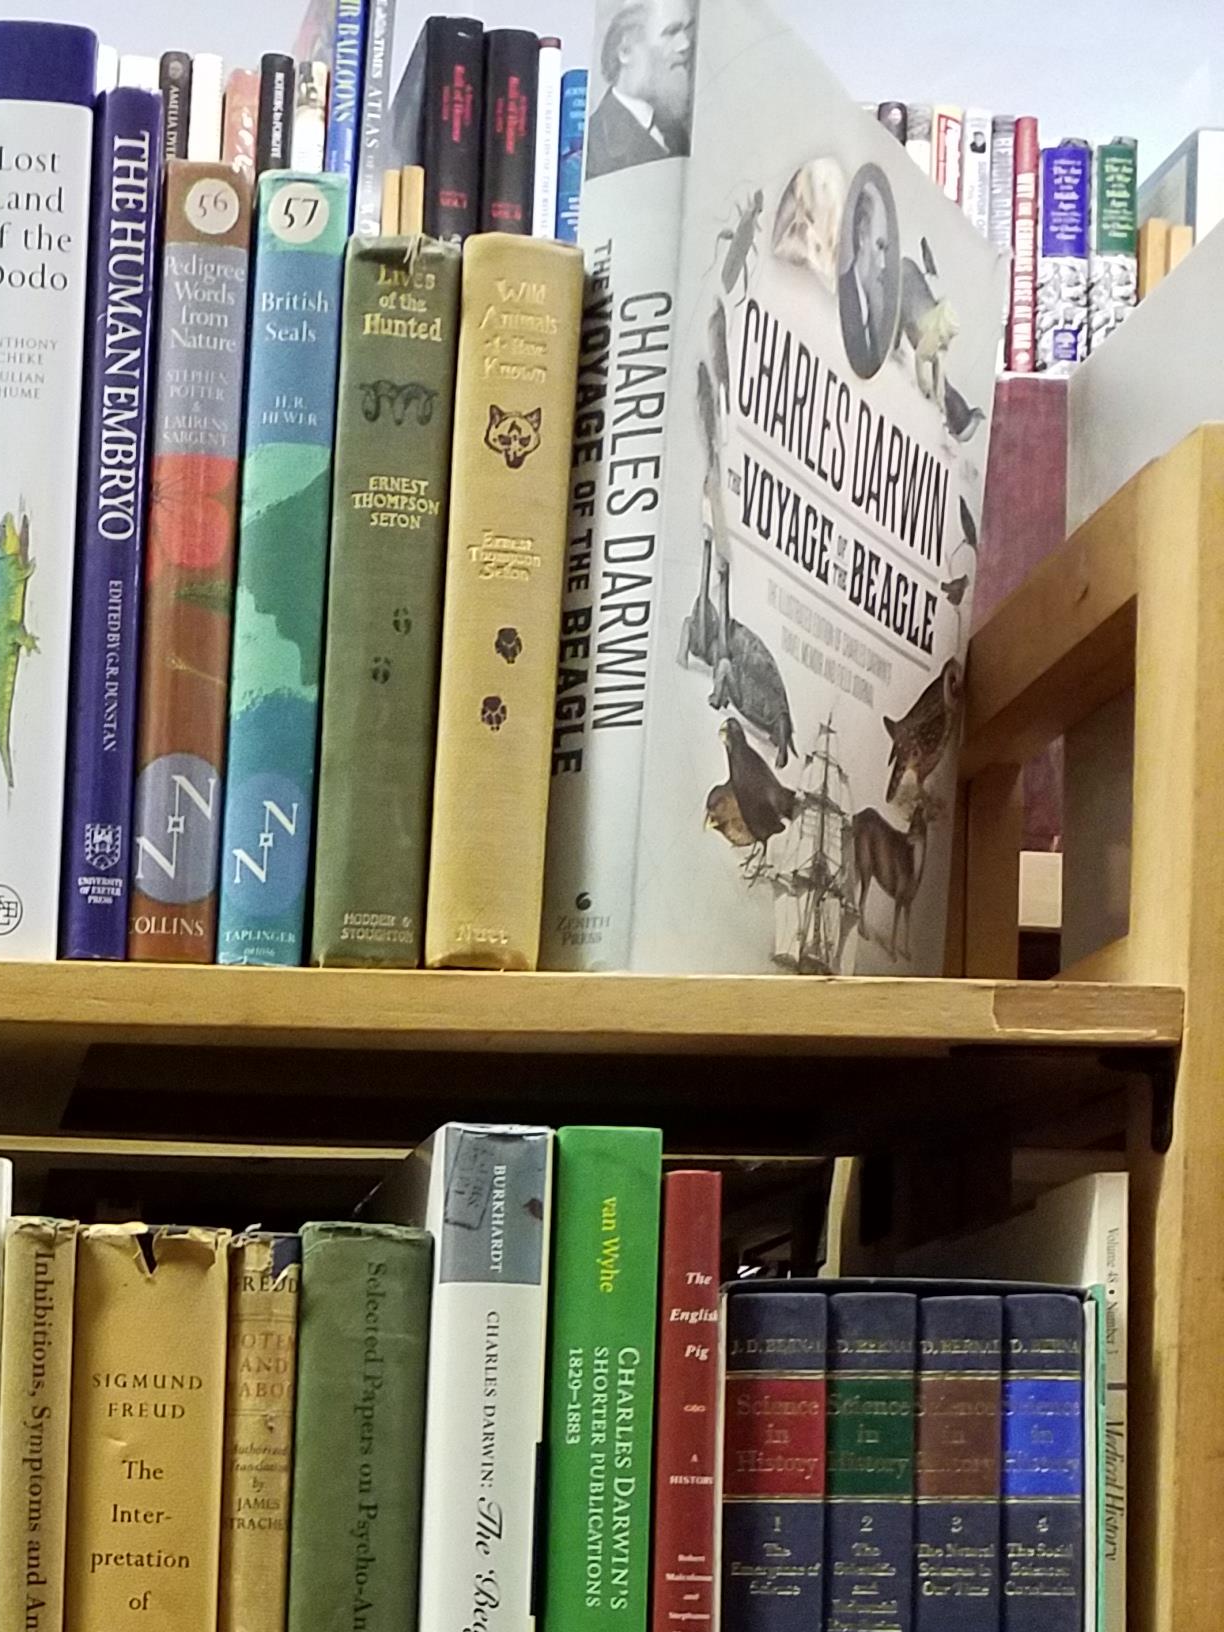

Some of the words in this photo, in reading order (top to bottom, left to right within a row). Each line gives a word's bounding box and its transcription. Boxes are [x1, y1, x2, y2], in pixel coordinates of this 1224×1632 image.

[110, 130, 150, 214] THE
[196, 193, 225, 218] 56
[282, 197, 320, 229] 57
[22, 225, 72, 253] the
[164, 256, 246, 283] Pedigree
[591, 239, 612, 291] THE
[103, 219, 148, 378] HUMAN
[174, 281, 235, 306] Words
[261, 292, 329, 313] British
[379, 294, 397, 313] of
[400, 293, 427, 313] the
[179, 305, 229, 329] from
[362, 313, 442, 343] Hunted
[170, 328, 236, 354] Nature
[266, 323, 317, 343] Seals
[572, 292, 613, 468] VOYAGE
[607, 291, 673, 516] CHARLES
[738, 299, 851, 492] CHARLES
[850, 399, 949, 567] DARWIN
[97, 385, 142, 541] EMBRYO
[368, 476, 428, 494] ERNEST
[571, 480, 596, 517] OF
[352, 493, 440, 516] THOMPSON
[370, 511, 421, 529] SETON
[567, 528, 593, 593] THE
[740, 453, 834, 586] VOYAGE
[848, 538, 938, 655] BEAGLE
[592, 534, 656, 729] DARWIN
[551, 605, 593, 776] BEAGLE
[489, 1164, 507, 1273] BURKHARDT
[600, 1196, 617, 1232] van
[598, 1237, 620, 1294] Wyhe
[686, 1271, 713, 1286] The
[669, 1308, 720, 1323] English
[685, 1344, 710, 1361] Pig
[92, 1373, 203, 1391] SIGMUND
[108, 1402, 185, 1420] FREUD
[615, 1347, 640, 1468] CHARLES
[122, 1459, 164, 1481] The
[111, 1504, 172, 1525] Inter-
[610, 1476, 636, 1610] DARWIN'S
[90, 1551, 191, 1573] pretation
[128, 1592, 151, 1611] of
